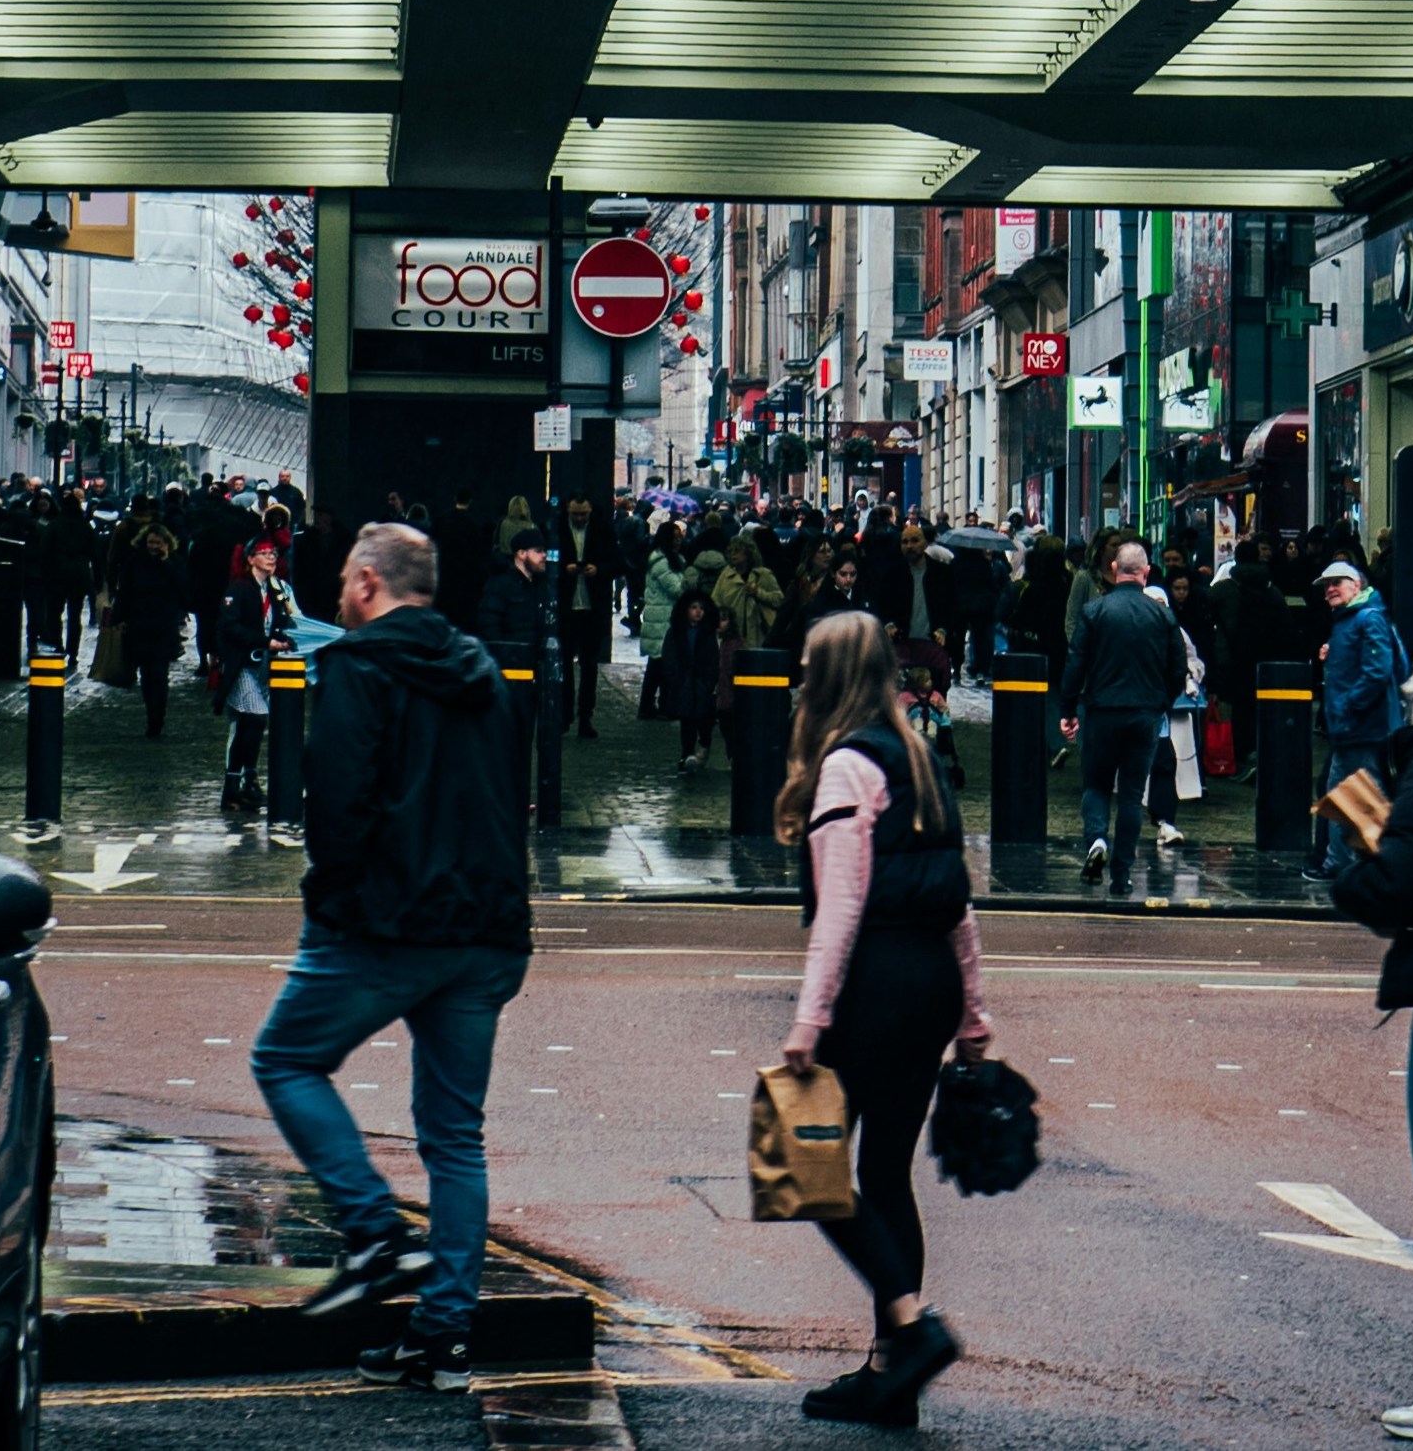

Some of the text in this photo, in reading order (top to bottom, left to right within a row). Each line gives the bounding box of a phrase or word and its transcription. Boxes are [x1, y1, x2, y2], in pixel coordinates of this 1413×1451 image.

[466, 252, 533, 264] ARNDALE
[396, 243, 542, 309] food
[391, 310, 543, 330] COURT
[51, 325, 70, 335] UNI
[50, 336, 73, 347] QLO
[492, 346, 544, 362] LIFTS
[909, 348, 948, 358] TESCO
[70, 355, 89, 364] UNI
[1027, 355, 1061, 369] NEY
[908, 362, 947, 372] express
